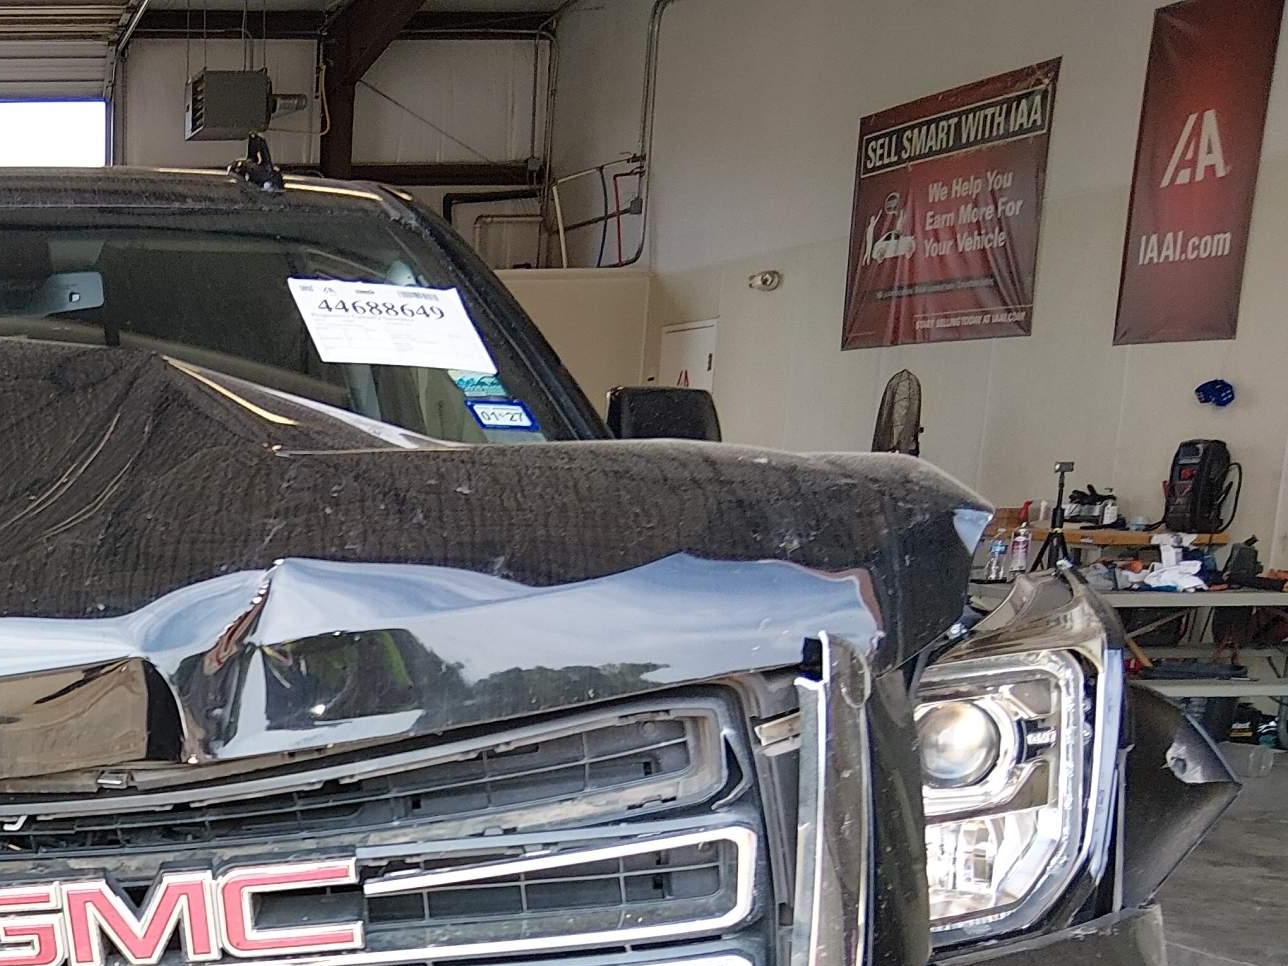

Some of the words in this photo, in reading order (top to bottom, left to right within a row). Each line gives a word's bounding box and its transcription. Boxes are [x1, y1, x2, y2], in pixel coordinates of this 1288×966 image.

[866, 134, 899, 169] SELL
[901, 116, 960, 159] SMART
[961, 103, 1008, 145] WITH
[1009, 94, 1043, 132] IAA
[928, 181, 948, 202] We
[951, 175, 982, 198] Help
[986, 169, 1014, 191] You
[925, 210, 955, 231] Earn
[958, 203, 995, 224] More
[997, 197, 1024, 217] For
[924, 238, 954, 257] Your
[956, 226, 1007, 253] Vehicle
[1138, 230, 1232, 265] IAAI.com
[317, 299, 445, 320] 44688649
